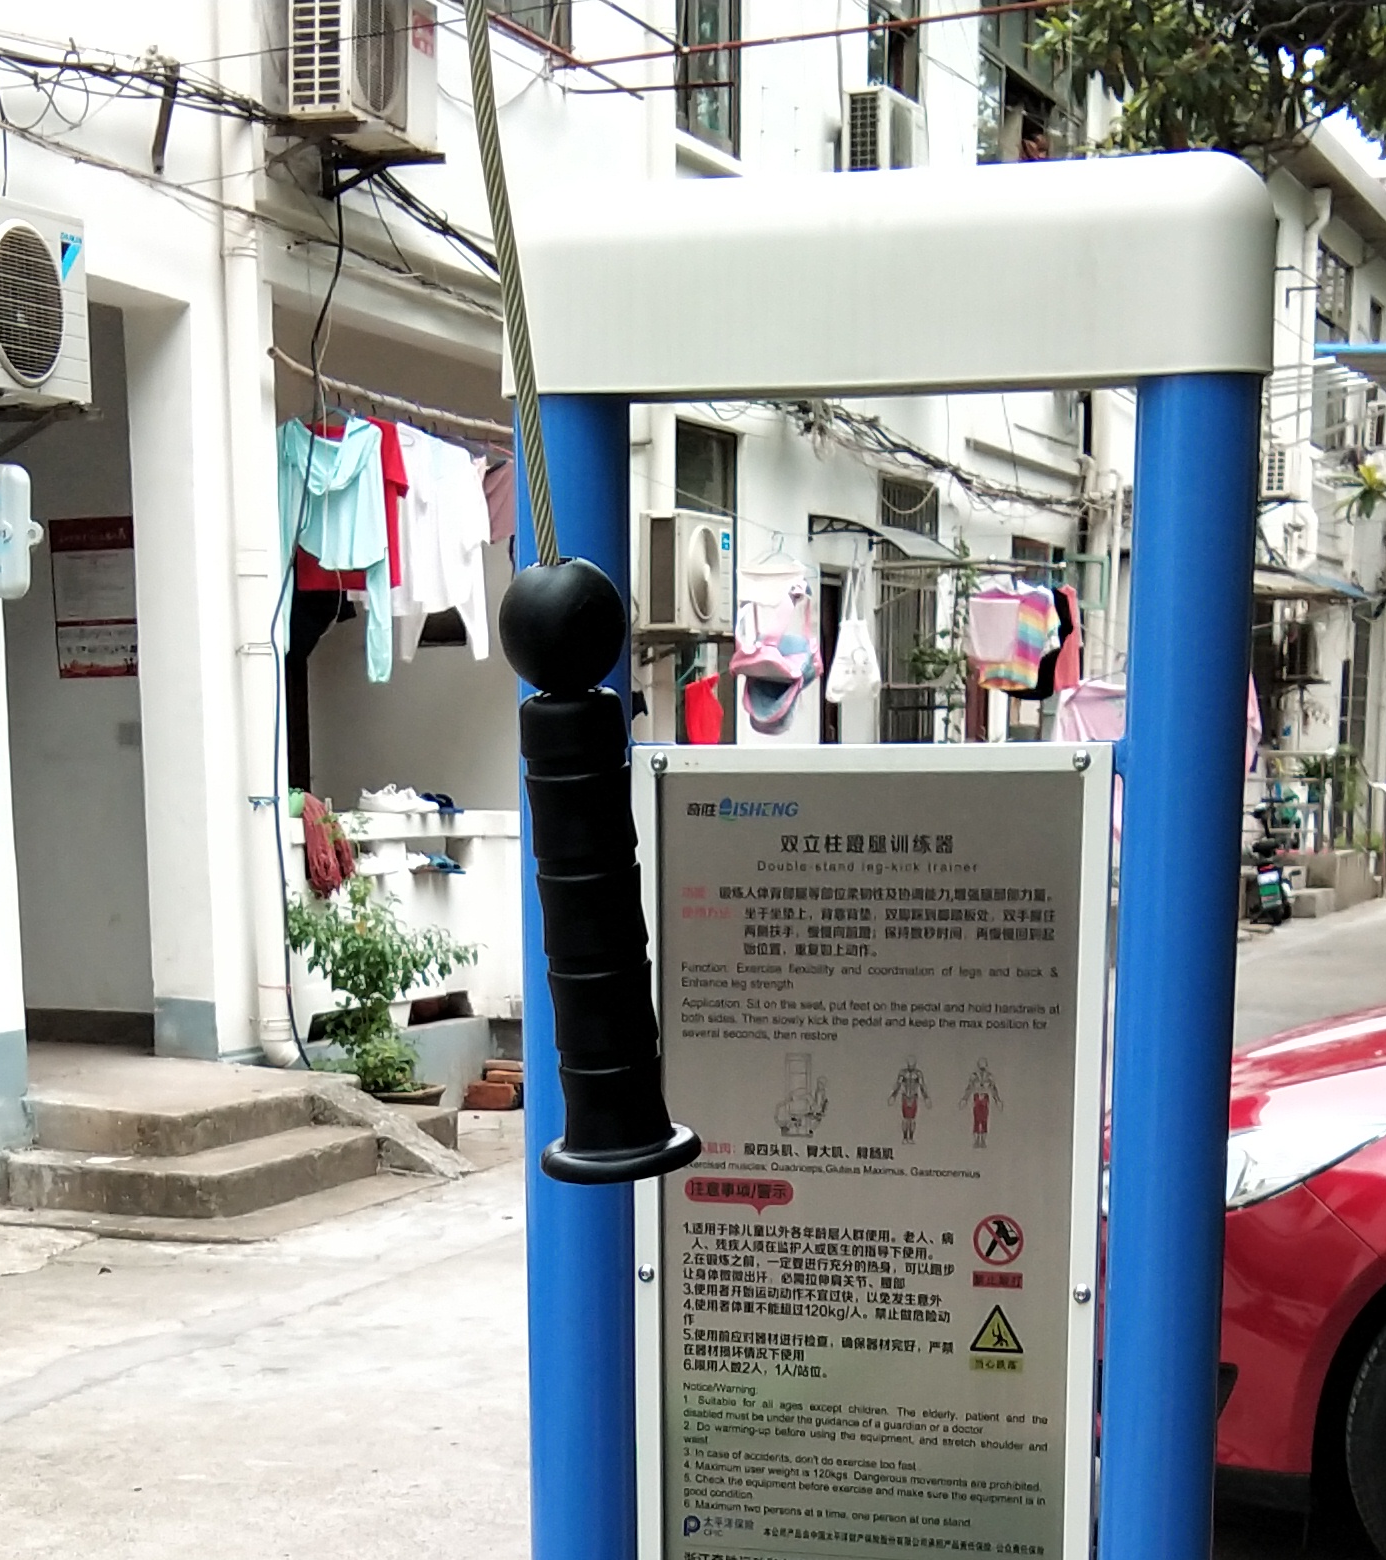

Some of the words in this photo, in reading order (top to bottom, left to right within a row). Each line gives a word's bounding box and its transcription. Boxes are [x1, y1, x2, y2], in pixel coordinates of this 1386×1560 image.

[861, 863, 920, 874] leg-kick
[927, 863, 978, 872] trainer
[736, 962, 781, 973] Exercise
[841, 965, 861, 974] and
[868, 966, 934, 975] coordination
[959, 967, 981, 978] legs
[989, 968, 1009, 976] and
[1016, 968, 1041, 977] back
[681, 977, 728, 987] Enhance
[731, 979, 746, 990] leg
[750, 979, 793, 990] strength
[747, 998, 759, 1008] Sit
[764, 1000, 776, 1008] on
[780, 999, 796, 1009] the
[829, 1001, 845, 1012] put
[849, 1000, 869, 1010] feet
[873, 1002, 886, 1011] on
[890, 1002, 907, 1011] the
[911, 1003, 940, 1012] pedal
[944, 1004, 964, 1012] and
[968, 1003, 991, 1012] hold
[681, 1013, 704, 1022] both
[741, 1013, 768, 1023] Then
[771, 1016, 805, 1025] slowly
[807, 1016, 828, 1024] kick
[831, 1016, 848, 1025] the
[851, 1016, 882, 1027] pedal
[884, 1018, 906, 1026] and
[908, 1018, 935, 1027] keep
[939, 1018, 956, 1027] the
[986, 1020, 1029, 1029] position
[1032, 1019, 1047, 1029] for
[682, 1029, 719, 1037] several
[723, 1030, 769, 1039] seconds,
[774, 1030, 796, 1039] then
[800, 1032, 837, 1040] restore
[910, 1167, 980, 1178] Gastrocnemius
[698, 1395, 736, 1406] Suitable
[742, 1398, 755, 1407] for
[761, 1400, 773, 1408] all
[779, 1402, 803, 1412] ages
[809, 1403, 841, 1413] except
[896, 1406, 915, 1417] The
[965, 1412, 999, 1422] patient
[1006, 1414, 1025, 1423] and
[1032, 1415, 1048, 1424] the
[683, 1409, 722, 1418] disabled
[725, 1412, 749, 1420] must
[751, 1412, 763, 1421] be
[766, 1414, 794, 1423] under
[797, 1415, 812, 1424] the
[815, 1417, 859, 1428] guidance
[883, 1421, 926, 1432] guardian
[951, 1425, 983, 1434] doctor
[696, 1422, 710, 1431] Do
[714, 1425, 770, 1436] warming-up
[775, 1427, 805, 1437] before
[810, 1430, 835, 1441] using
[840, 1431, 855, 1440] the
[919, 1436, 937, 1445] and
[942, 1438, 975, 1447] stretch
[980, 1440, 1023, 1450] shoulder
[1028, 1442, 1047, 1451] and
[706, 1450, 729, 1458] case
[743, 1452, 791, 1462] accidents,
[821, 1456, 833, 1465] do
[836, 1458, 877, 1468] exercise
[879, 1460, 895, 1469] too
[695, 1461, 741, 1472] Maximum
[744, 1466, 765, 1474] user
[767, 1467, 799, 1478] weight
[853, 1471, 907, 1484] Dangerous
[910, 1476, 967, 1487] movements
[971, 1480, 986, 1488] are
[988, 1480, 1041, 1492] prohibited.
[683, 1488, 707, 1497] good
[695, 1474, 725, 1484] Check
[728, 1477, 743, 1486] the
[745, 1479, 796, 1489] equipment
[798, 1481, 829, 1491] before
[831, 1485, 872, 1494] exercise
[875, 1487, 894, 1495] and
[896, 1489, 923, 1497] make
[926, 1491, 948, 1499] sure
[951, 1491, 967, 1500] the
[969, 1493, 1022, 1505] equipment
[694, 1500, 741, 1511] Maximum
[743, 1504, 760, 1513] two
[763, 1506, 801, 1516] persons
[851, 1512, 870, 1520] one
[872, 1513, 906, 1523] person
[921, 1517, 940, 1525] one
[943, 1518, 970, 1527] stand
